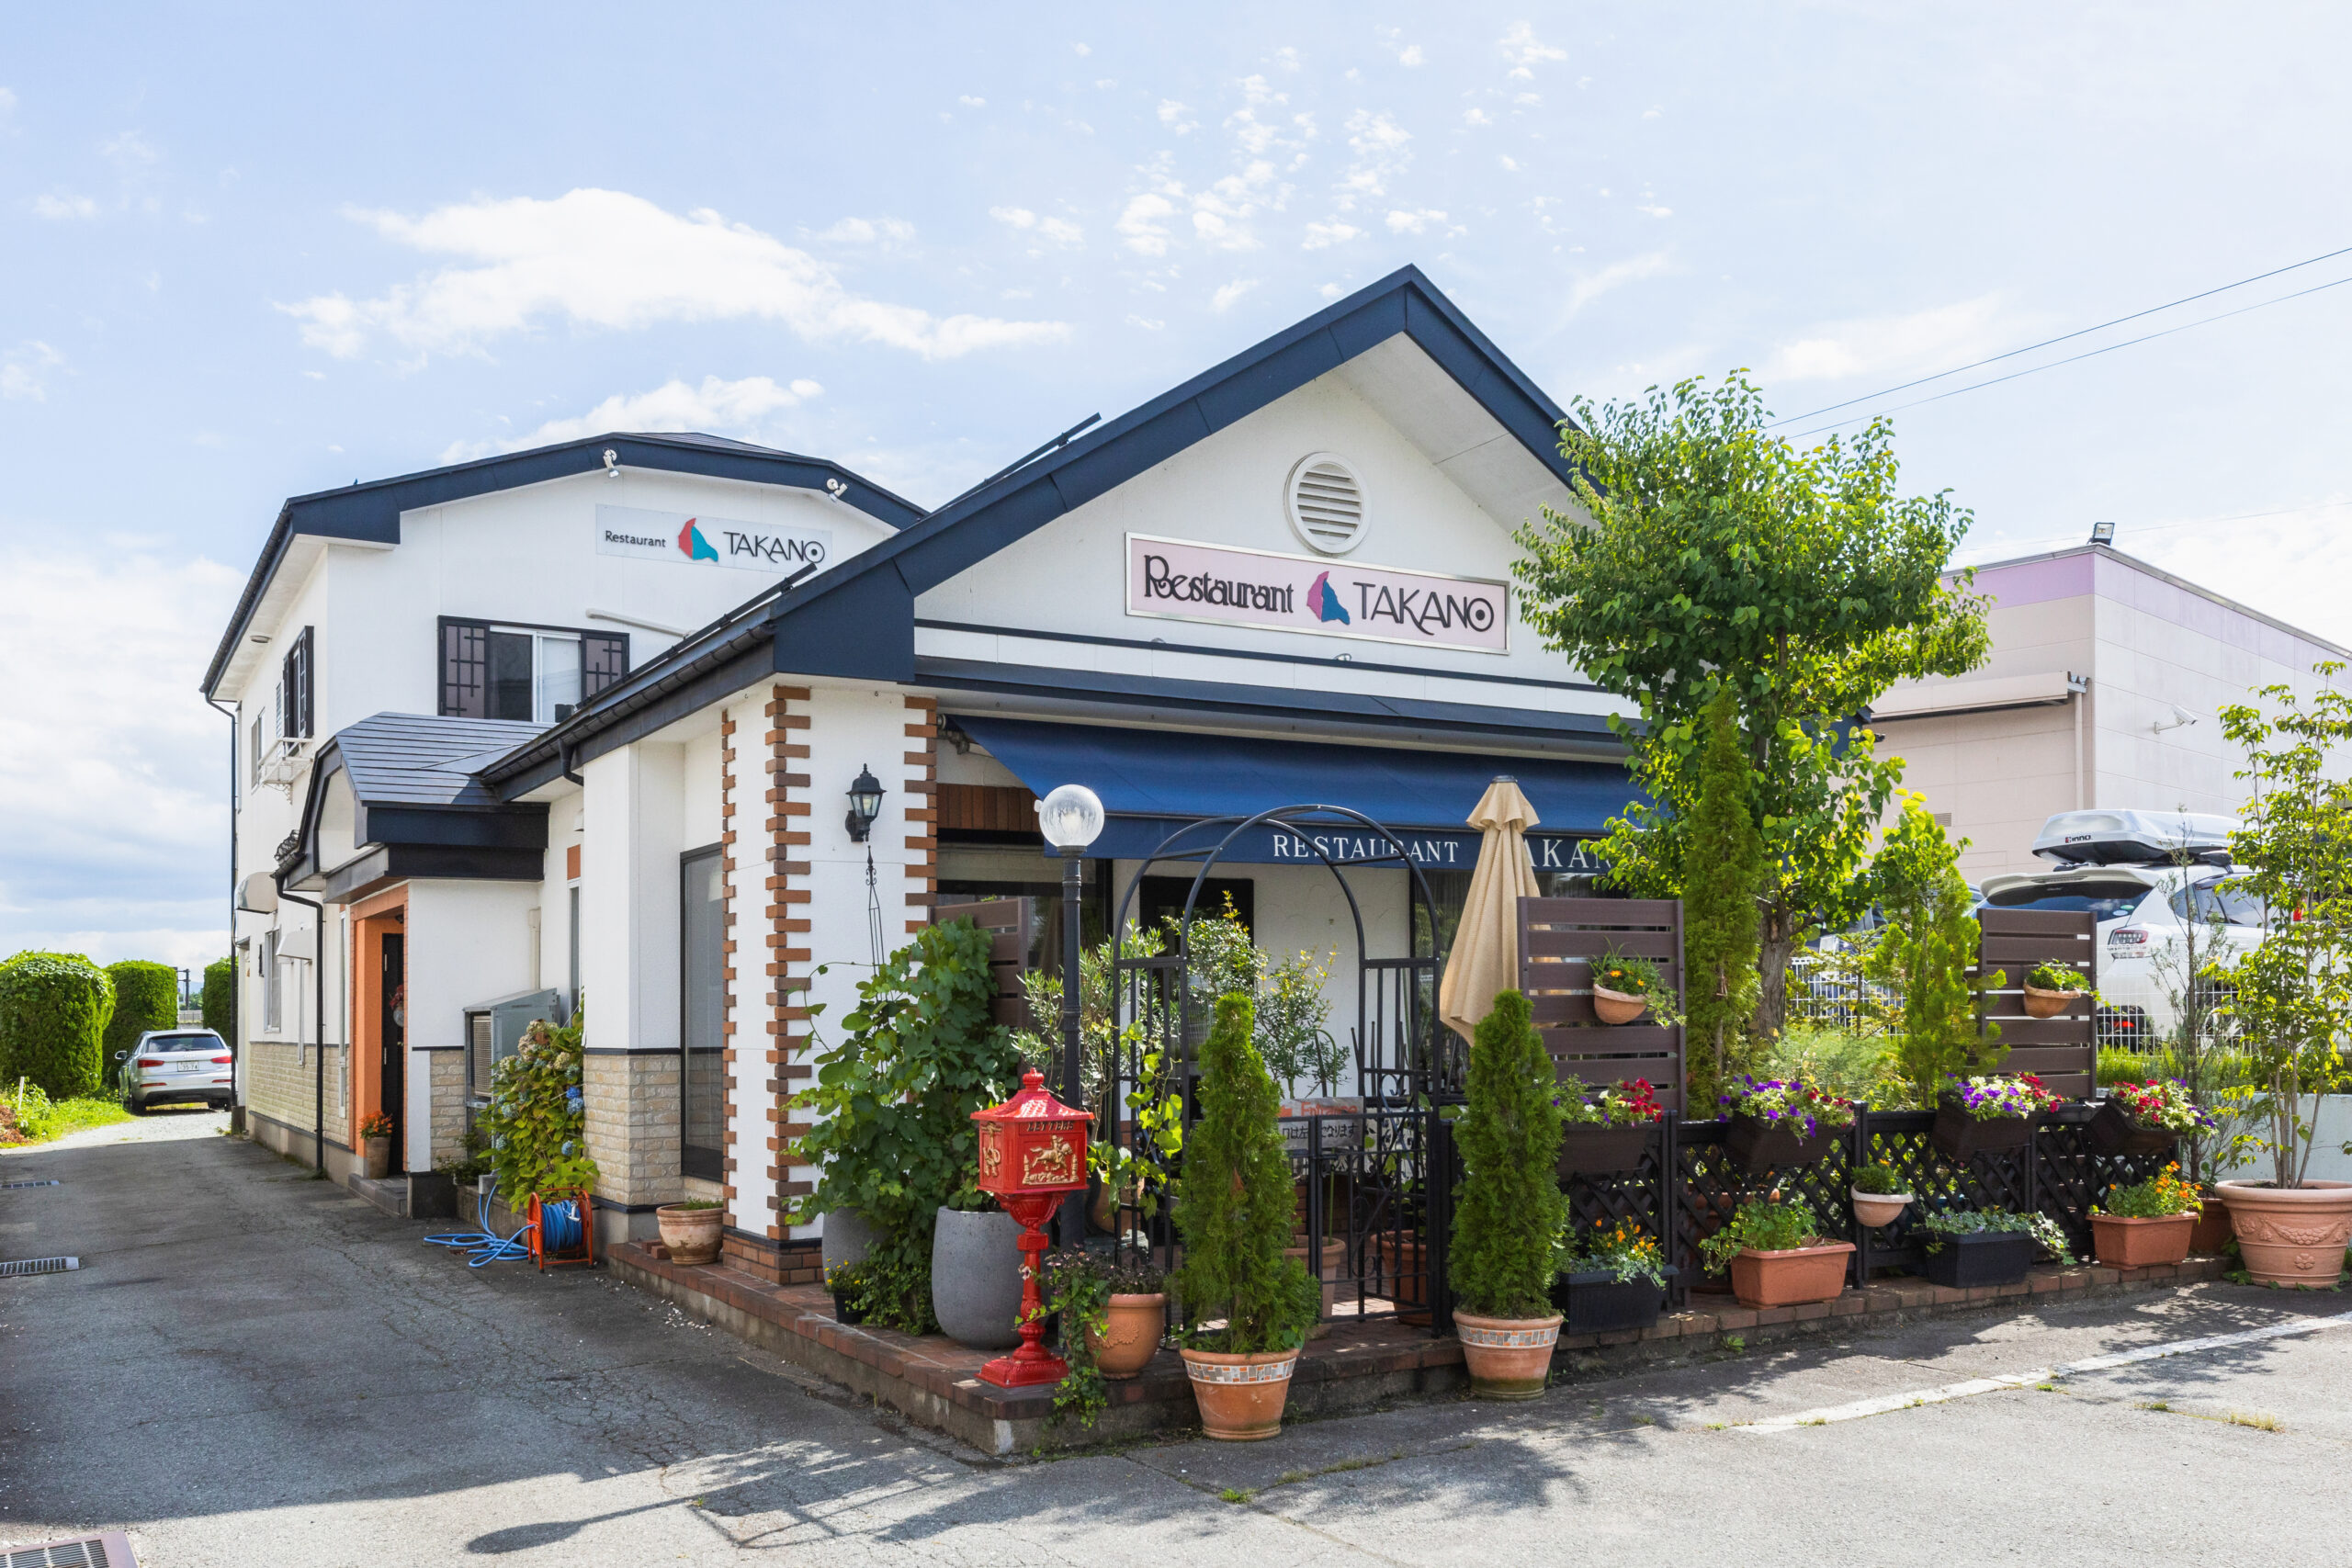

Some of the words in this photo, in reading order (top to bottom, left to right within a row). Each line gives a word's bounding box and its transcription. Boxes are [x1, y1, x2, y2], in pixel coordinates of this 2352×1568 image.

[605, 530, 666, 548] Restaurant
[723, 531, 825, 564] TAKANO
[1143, 555, 1295, 614] Restaurant
[1352, 581, 1495, 637] TAKANO
[1026, 1121, 1075, 1132] LETTERS
